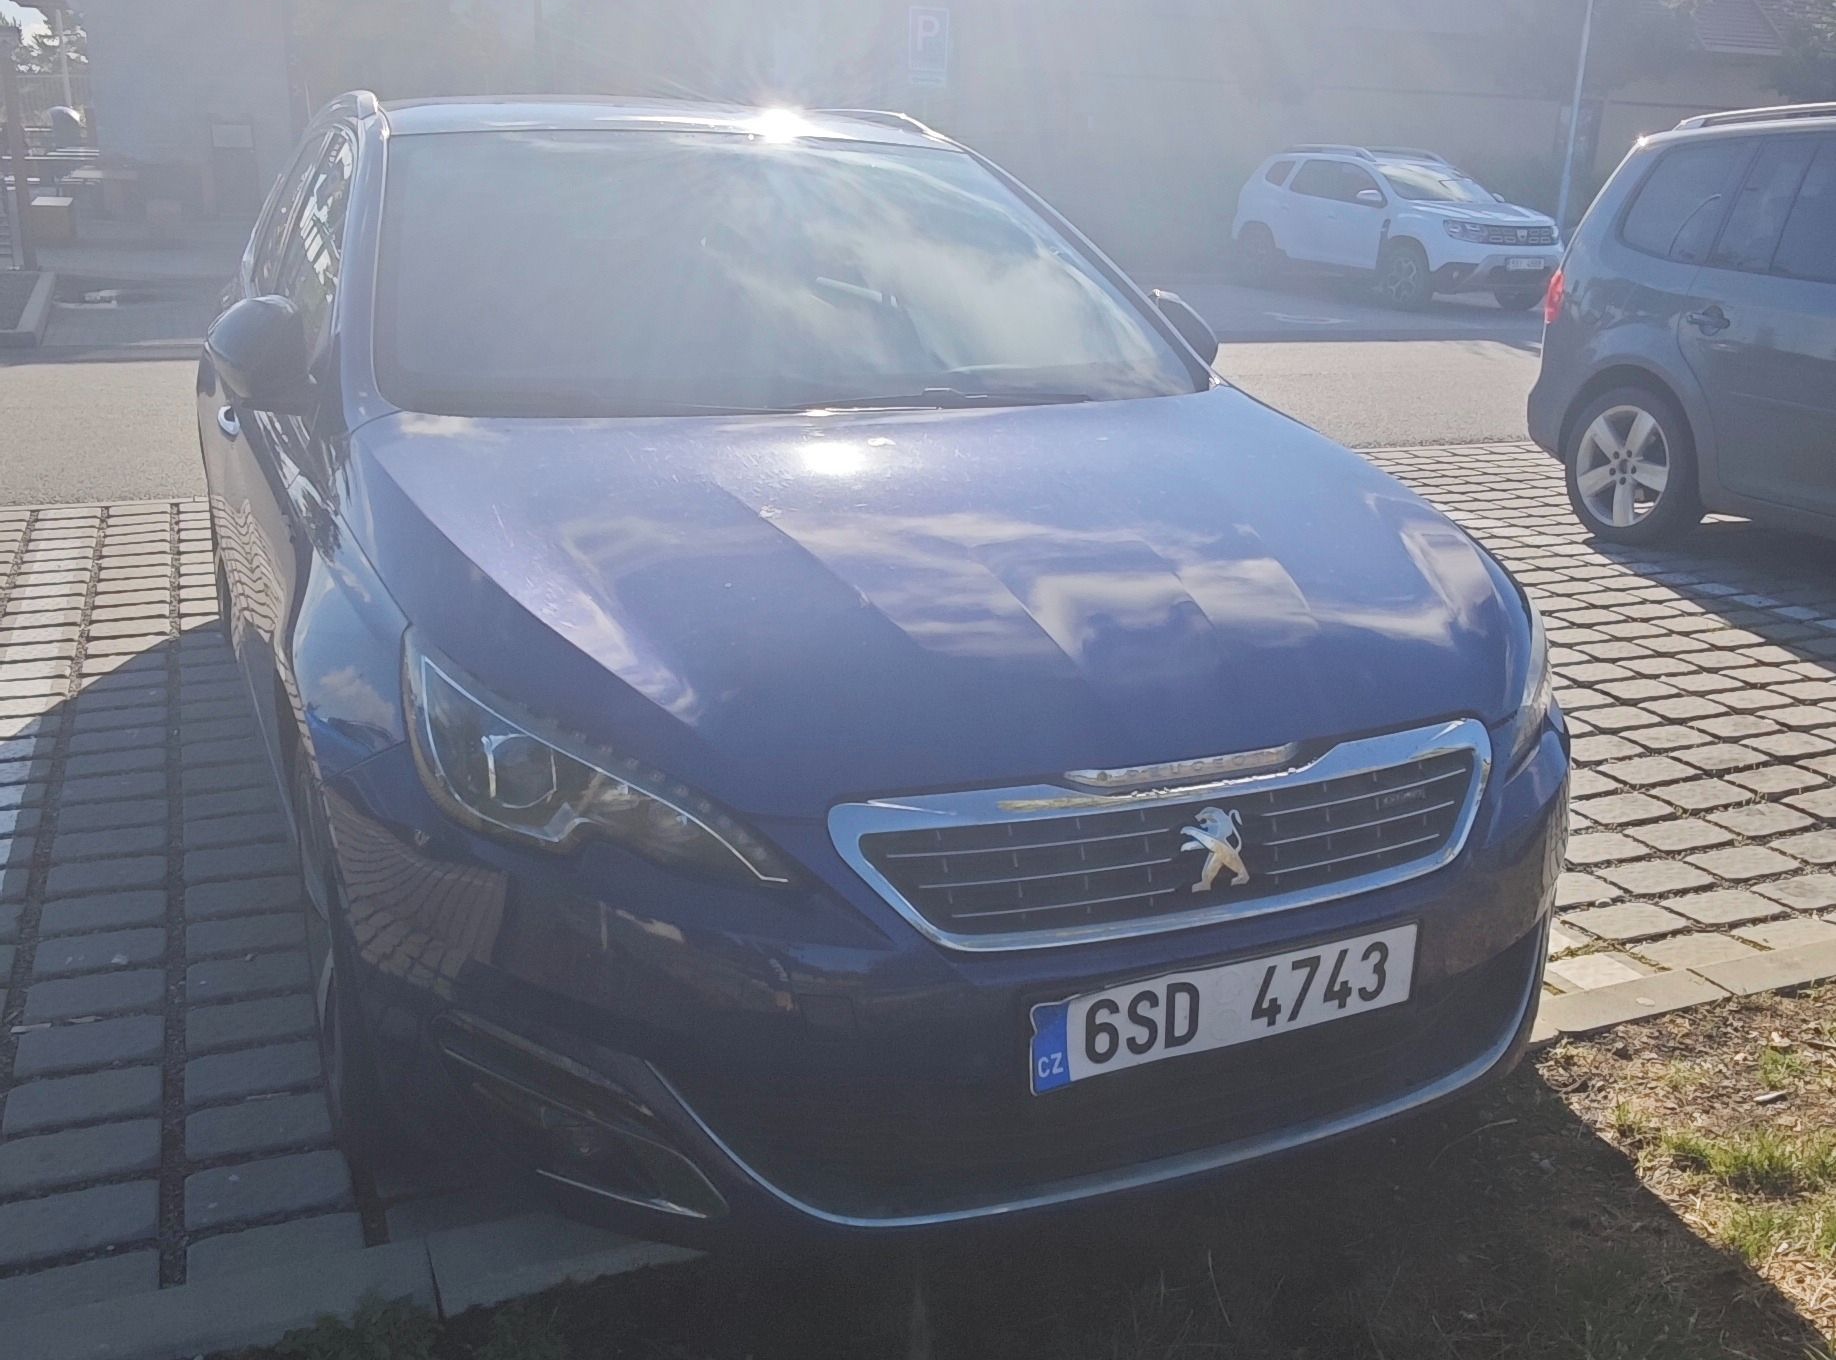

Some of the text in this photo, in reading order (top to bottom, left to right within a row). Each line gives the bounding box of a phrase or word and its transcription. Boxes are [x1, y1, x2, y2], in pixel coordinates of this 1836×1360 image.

[916, 15, 940, 51] P
[1085, 941, 1389, 1064] 6SD 4743
[1037, 1051, 1064, 1079] CZ
